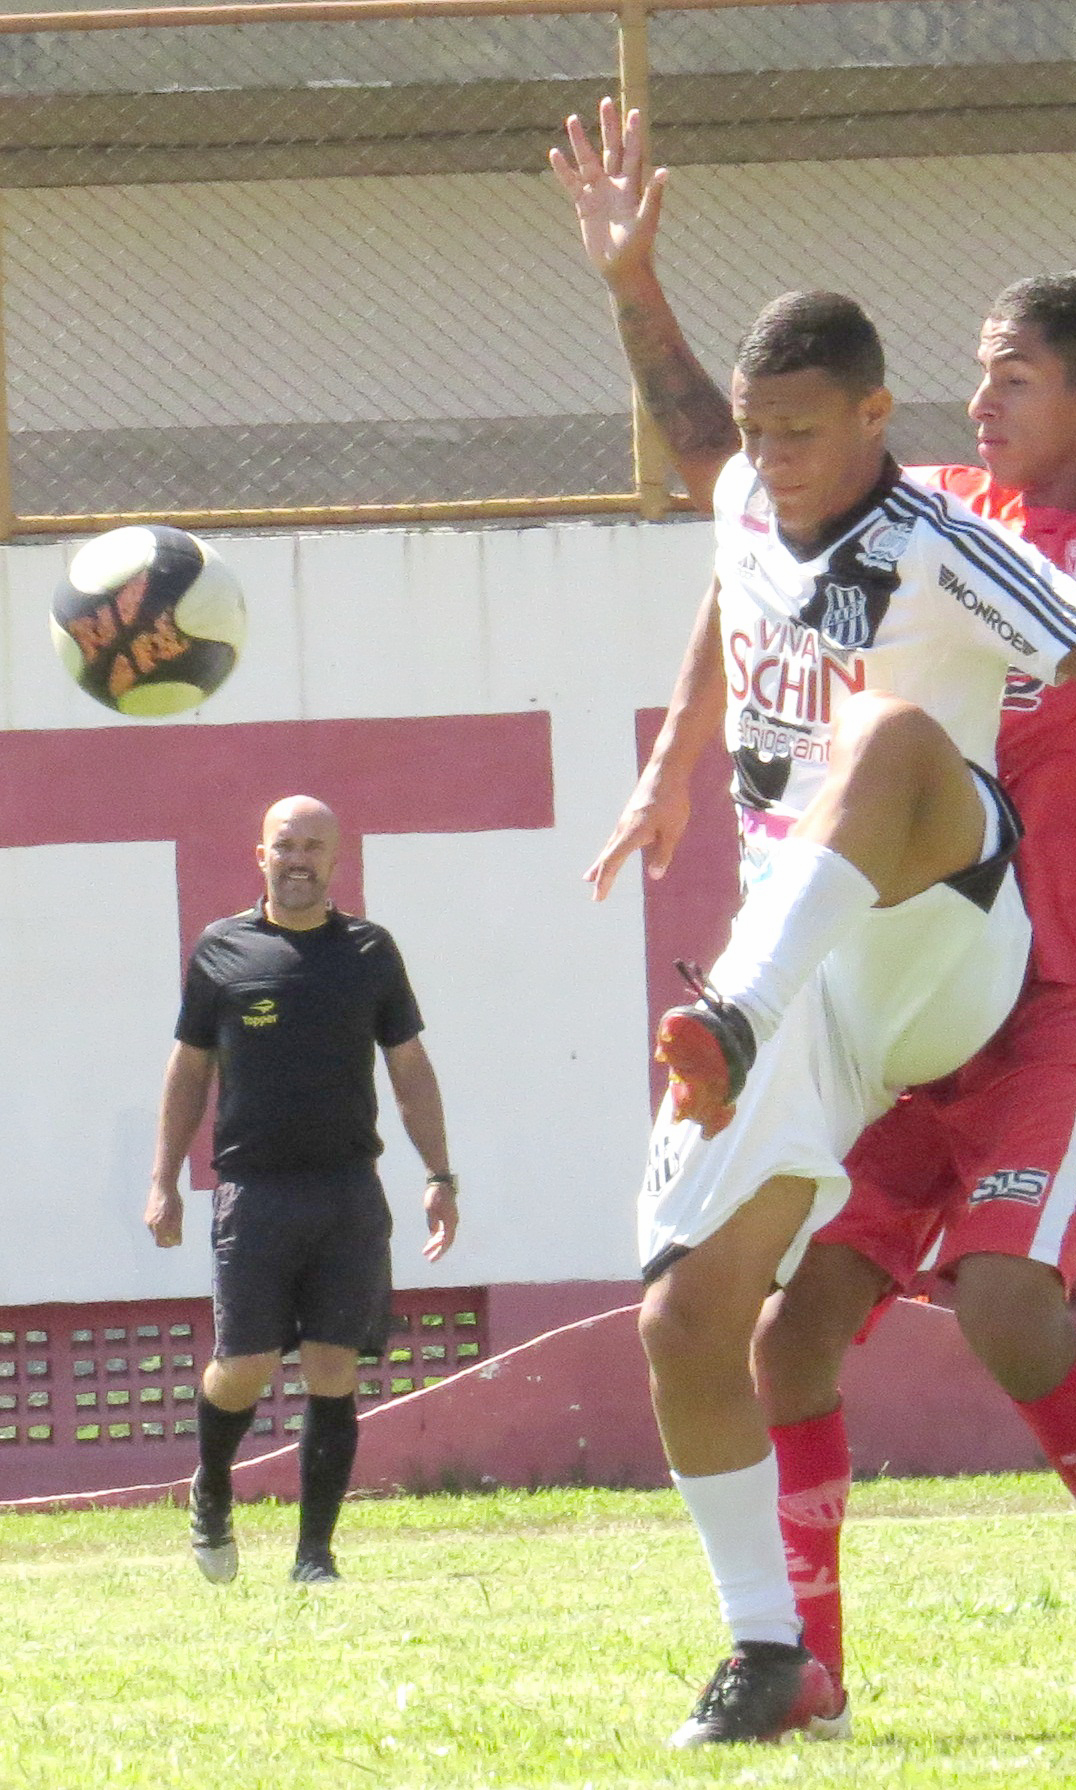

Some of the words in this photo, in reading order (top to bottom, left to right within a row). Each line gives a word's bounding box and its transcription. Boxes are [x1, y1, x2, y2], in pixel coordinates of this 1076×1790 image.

[759, 619, 817, 664] VIVA
[944, 570, 1033, 655] MONROE
[730, 631, 866, 724] SCHIN
